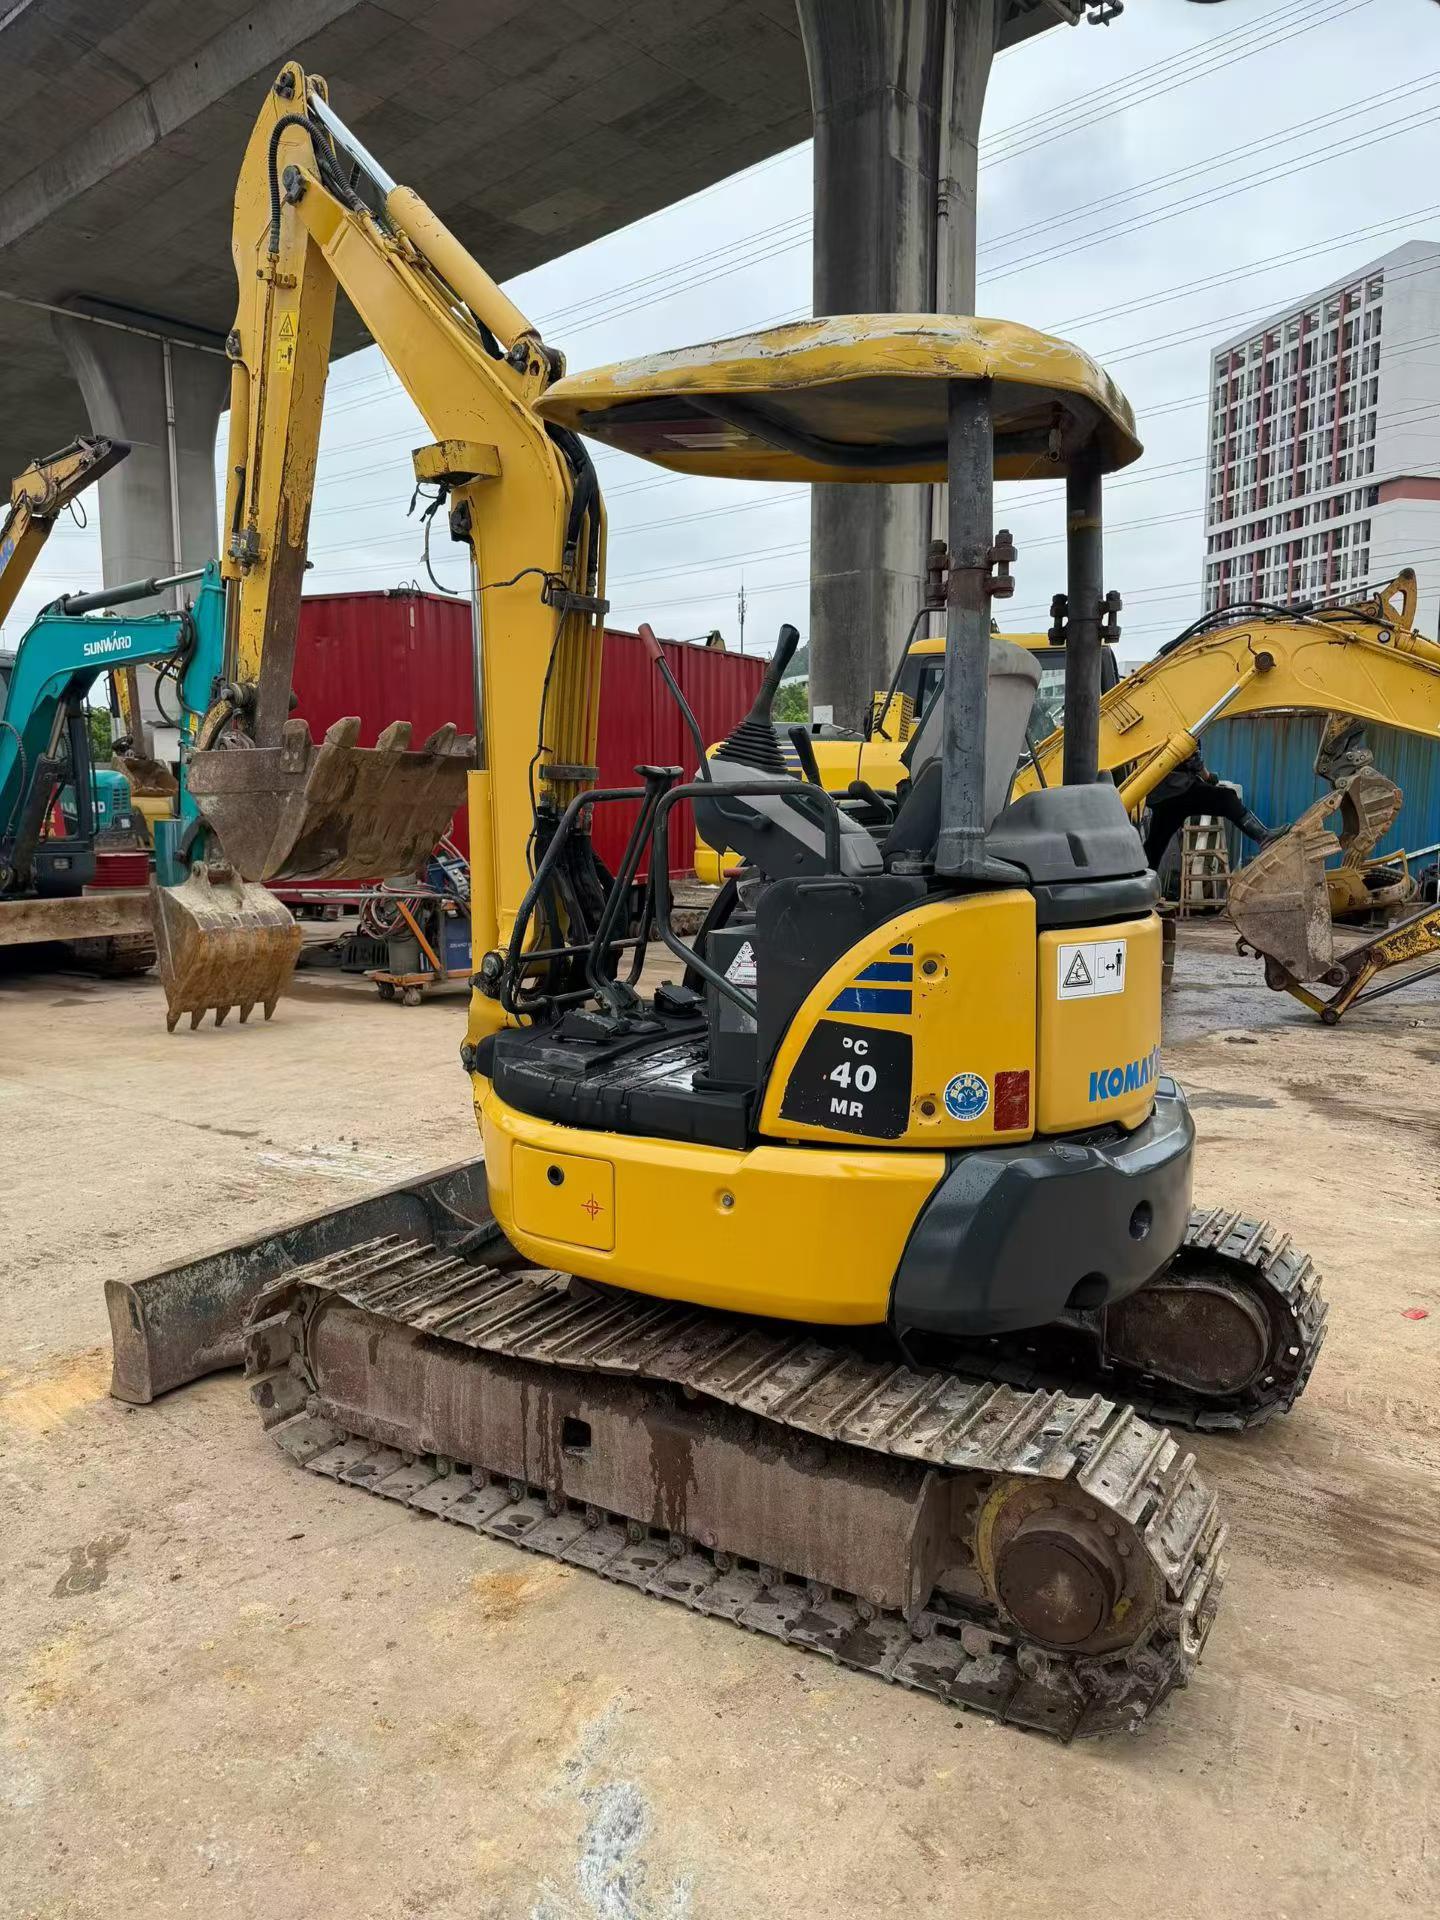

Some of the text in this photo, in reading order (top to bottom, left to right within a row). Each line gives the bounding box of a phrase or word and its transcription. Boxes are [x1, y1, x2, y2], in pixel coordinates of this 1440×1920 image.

[84, 630, 132, 657] SUNWARD
[830, 1061, 877, 1093] 40
[1088, 1044, 1160, 1102] KOMAT
[830, 1097, 864, 1118] MR
